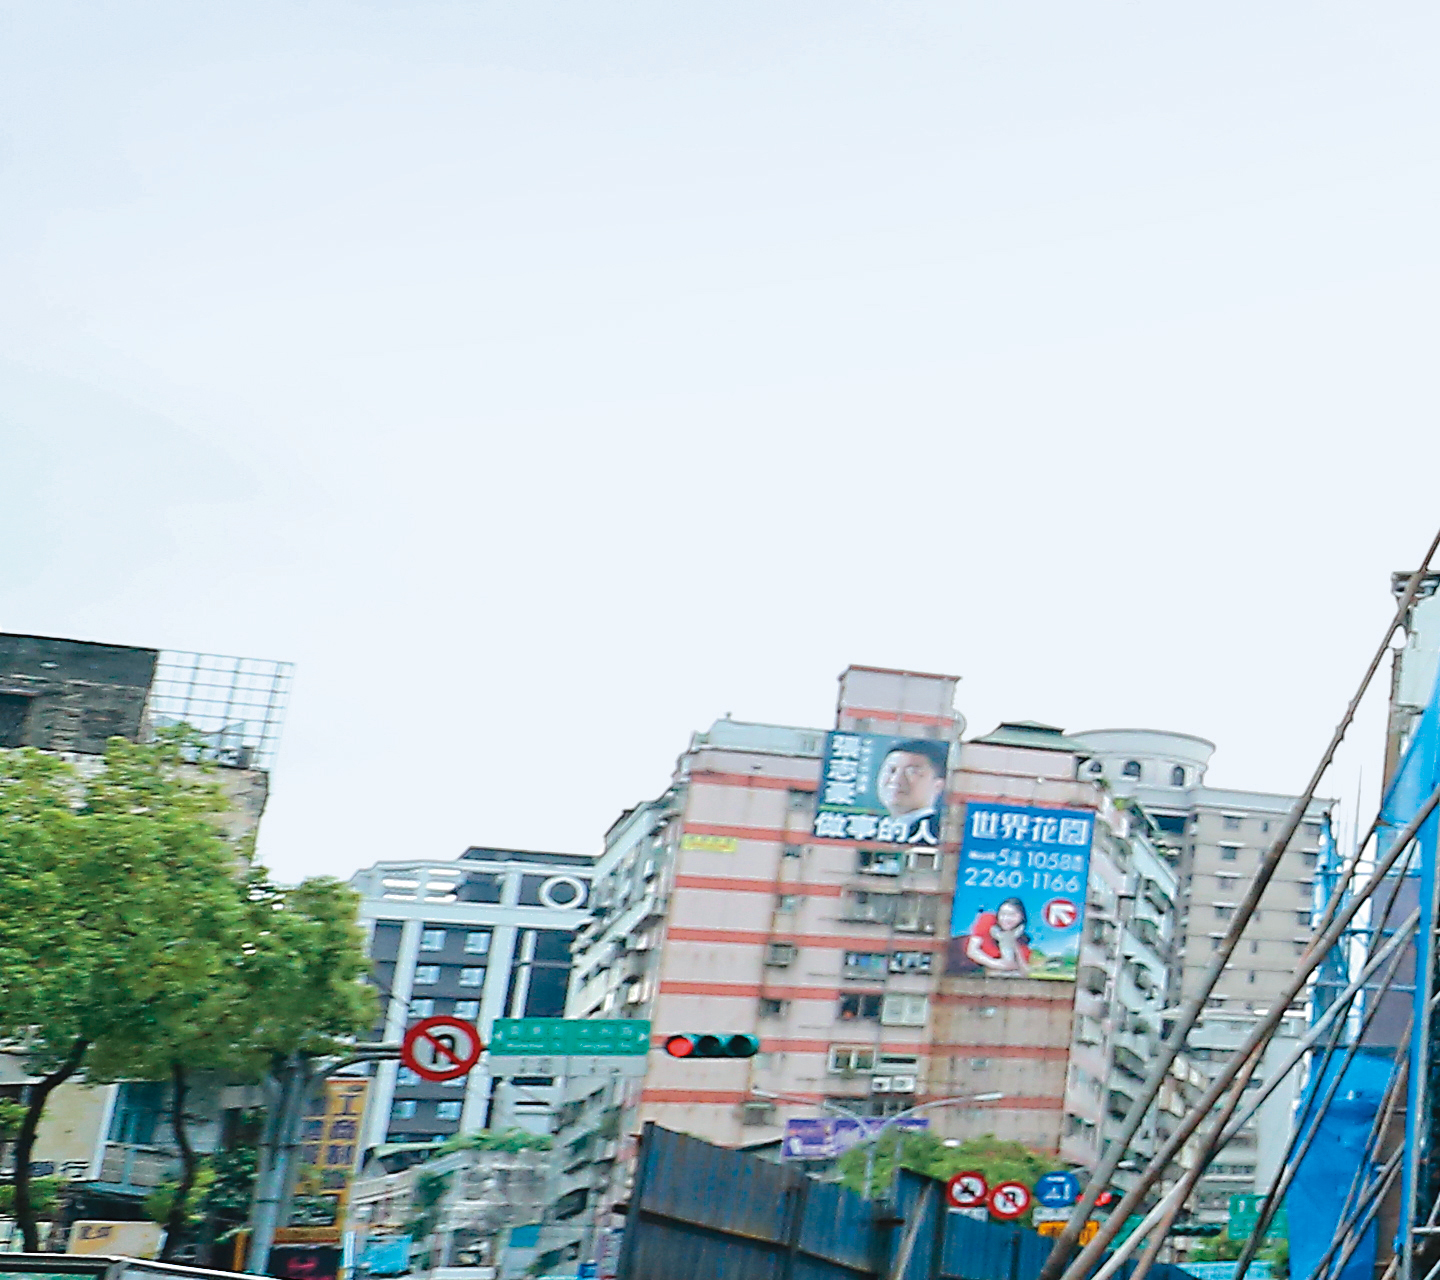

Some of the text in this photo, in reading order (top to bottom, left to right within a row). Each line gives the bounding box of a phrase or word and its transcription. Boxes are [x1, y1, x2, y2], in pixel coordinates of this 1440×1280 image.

[814, 811, 938, 845] 做事的人
[964, 866, 1081, 893] 2260-1166
